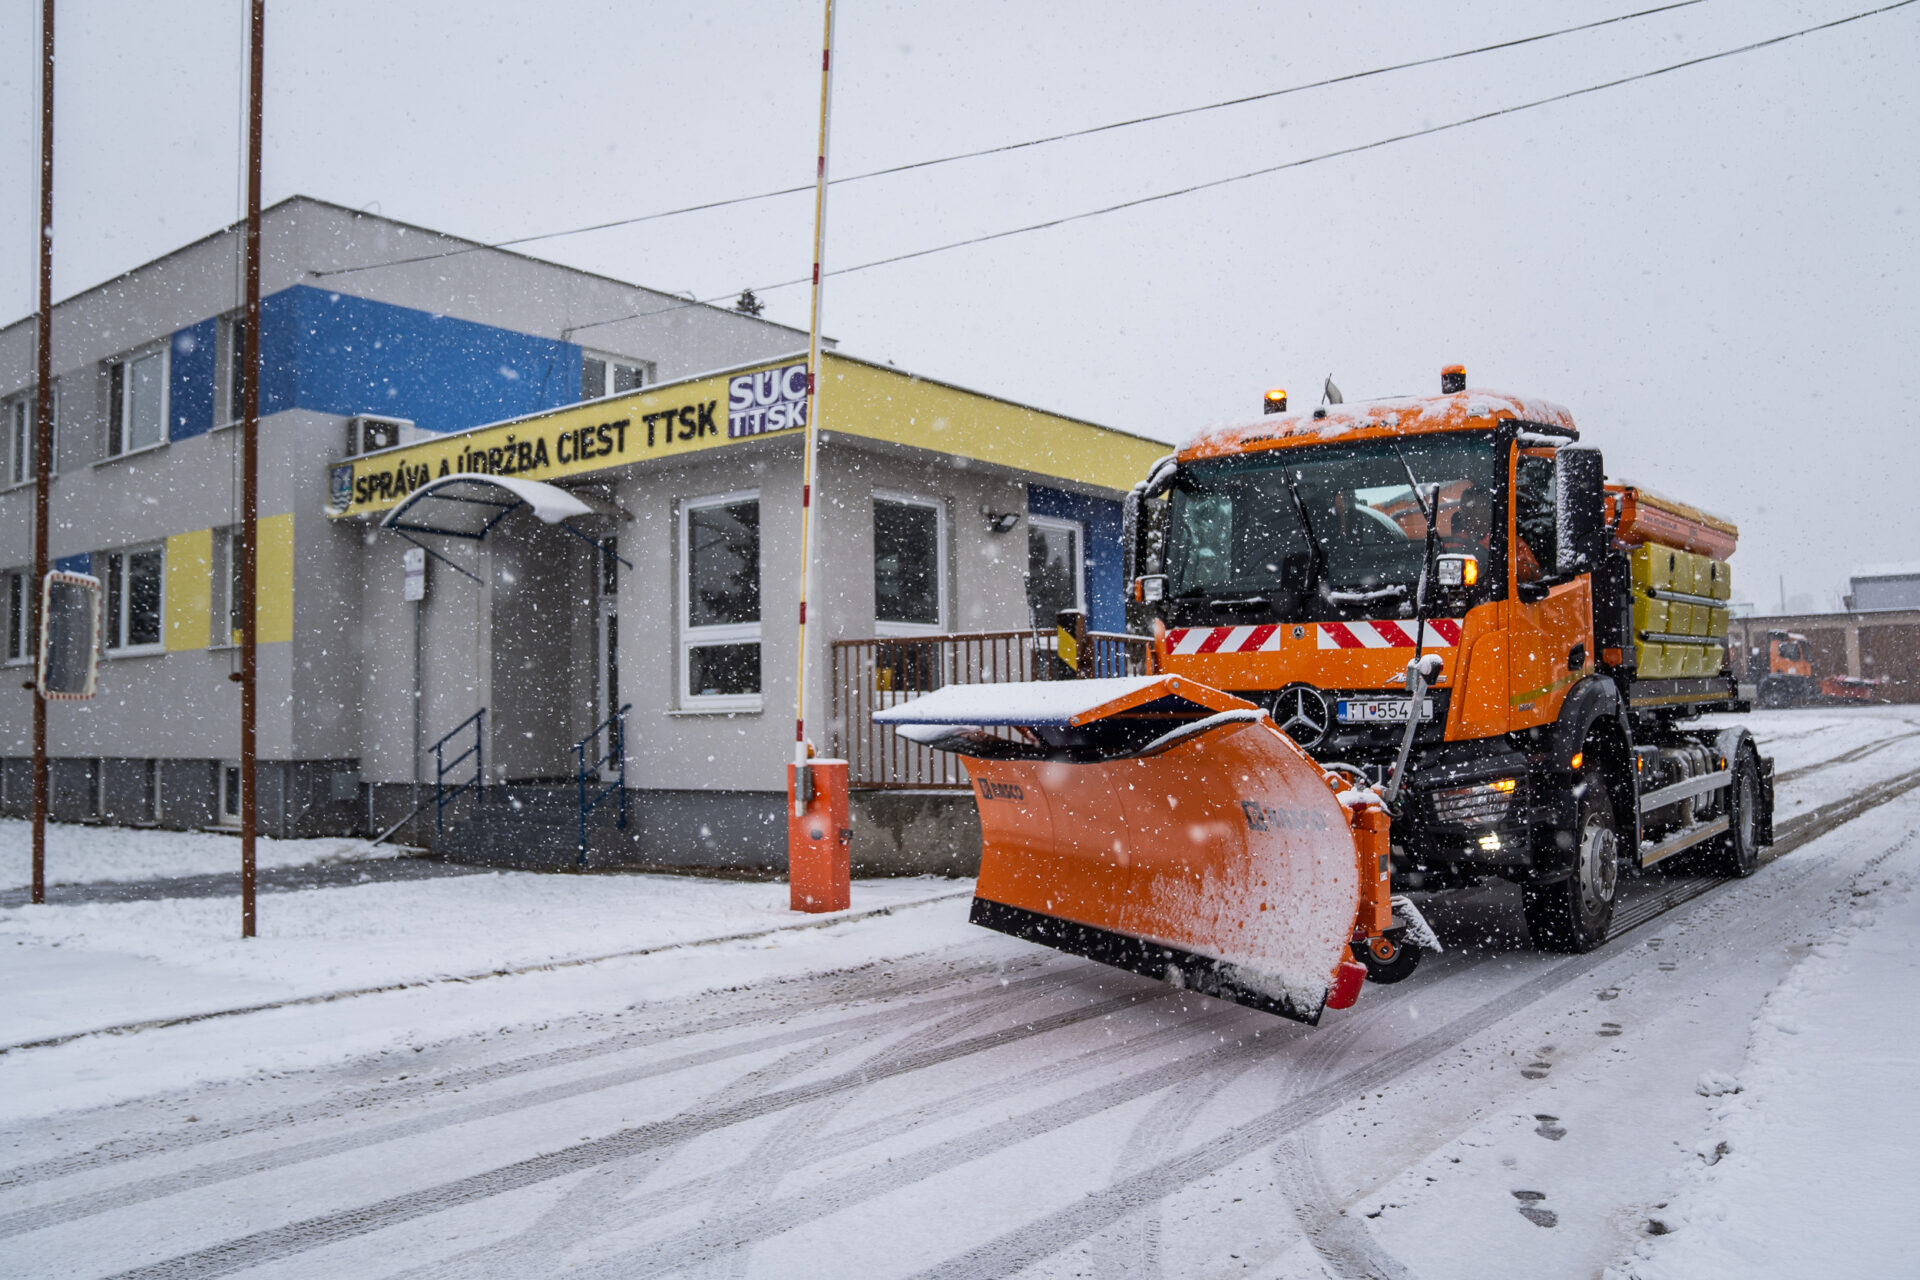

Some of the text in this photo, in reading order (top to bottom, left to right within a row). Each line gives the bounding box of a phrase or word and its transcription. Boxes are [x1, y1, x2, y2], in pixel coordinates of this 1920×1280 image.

[729, 365, 807, 411] SÚC
[729, 401, 807, 438] TTSK
[355, 460, 431, 504] SPRÁVA
[457, 434, 549, 475] ÚDRŽBA
[557, 419, 631, 465] CIEST
[642, 400, 719, 448] TTSK
[1377, 702, 1431, 719] 554L
